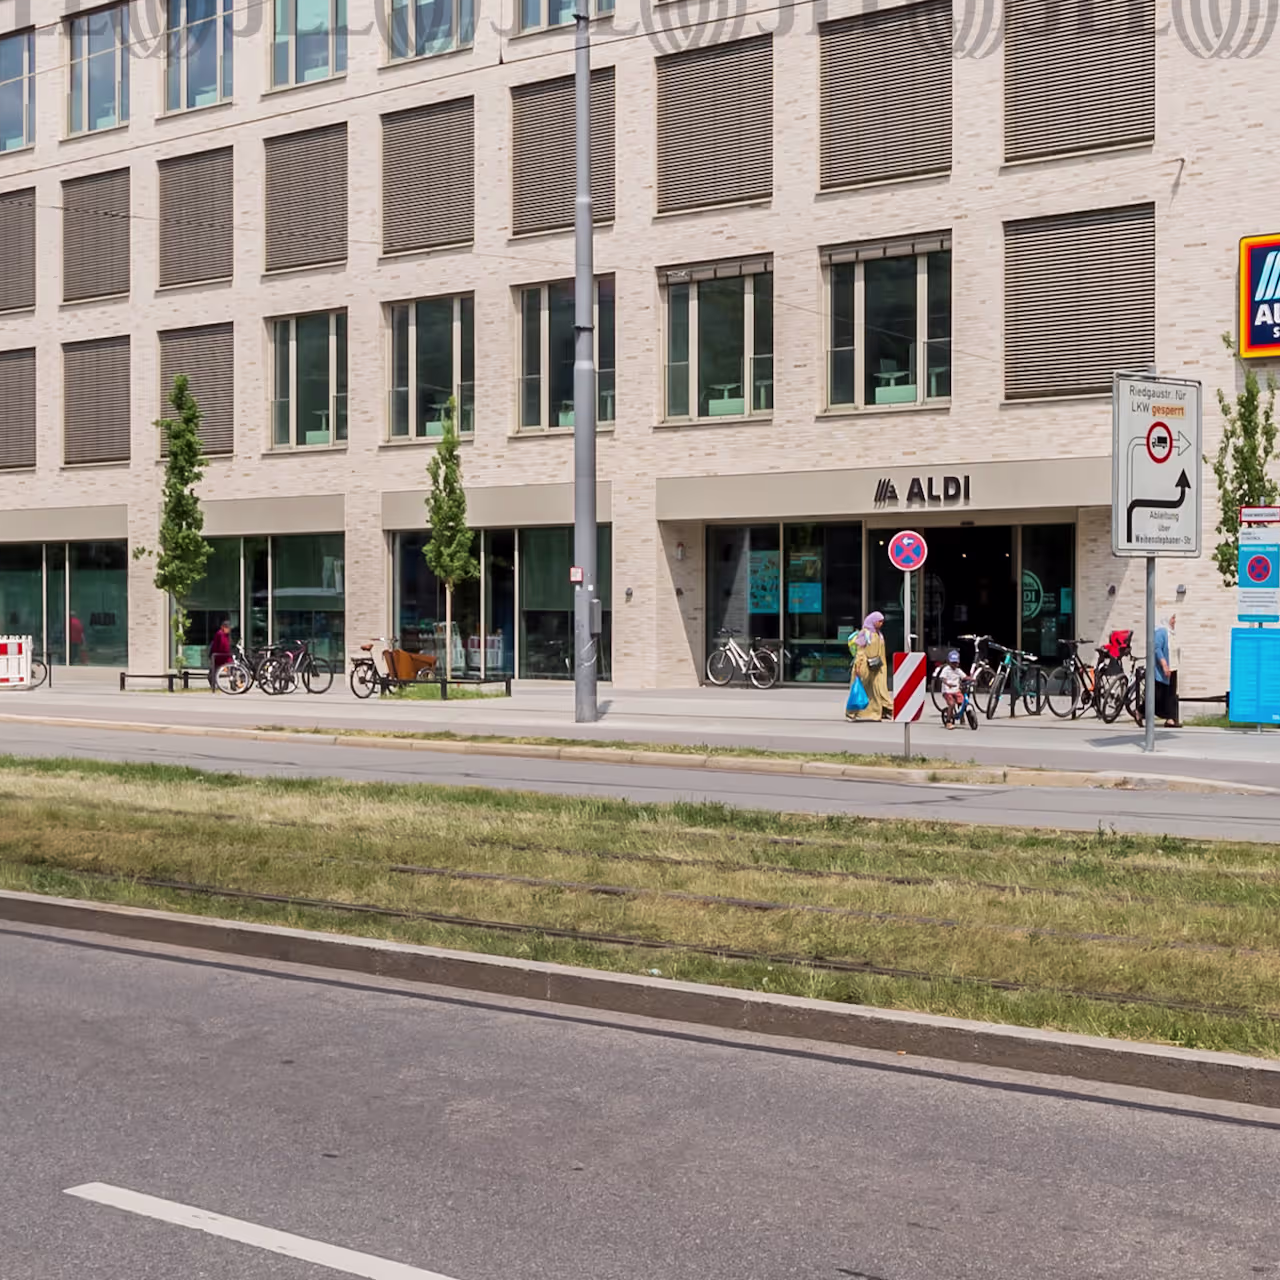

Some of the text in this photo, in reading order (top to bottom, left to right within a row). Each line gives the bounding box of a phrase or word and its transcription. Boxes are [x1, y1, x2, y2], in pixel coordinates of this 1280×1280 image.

[1131, 401, 1185, 417] LKW gesperrt
[906, 475, 970, 502] ALDI
